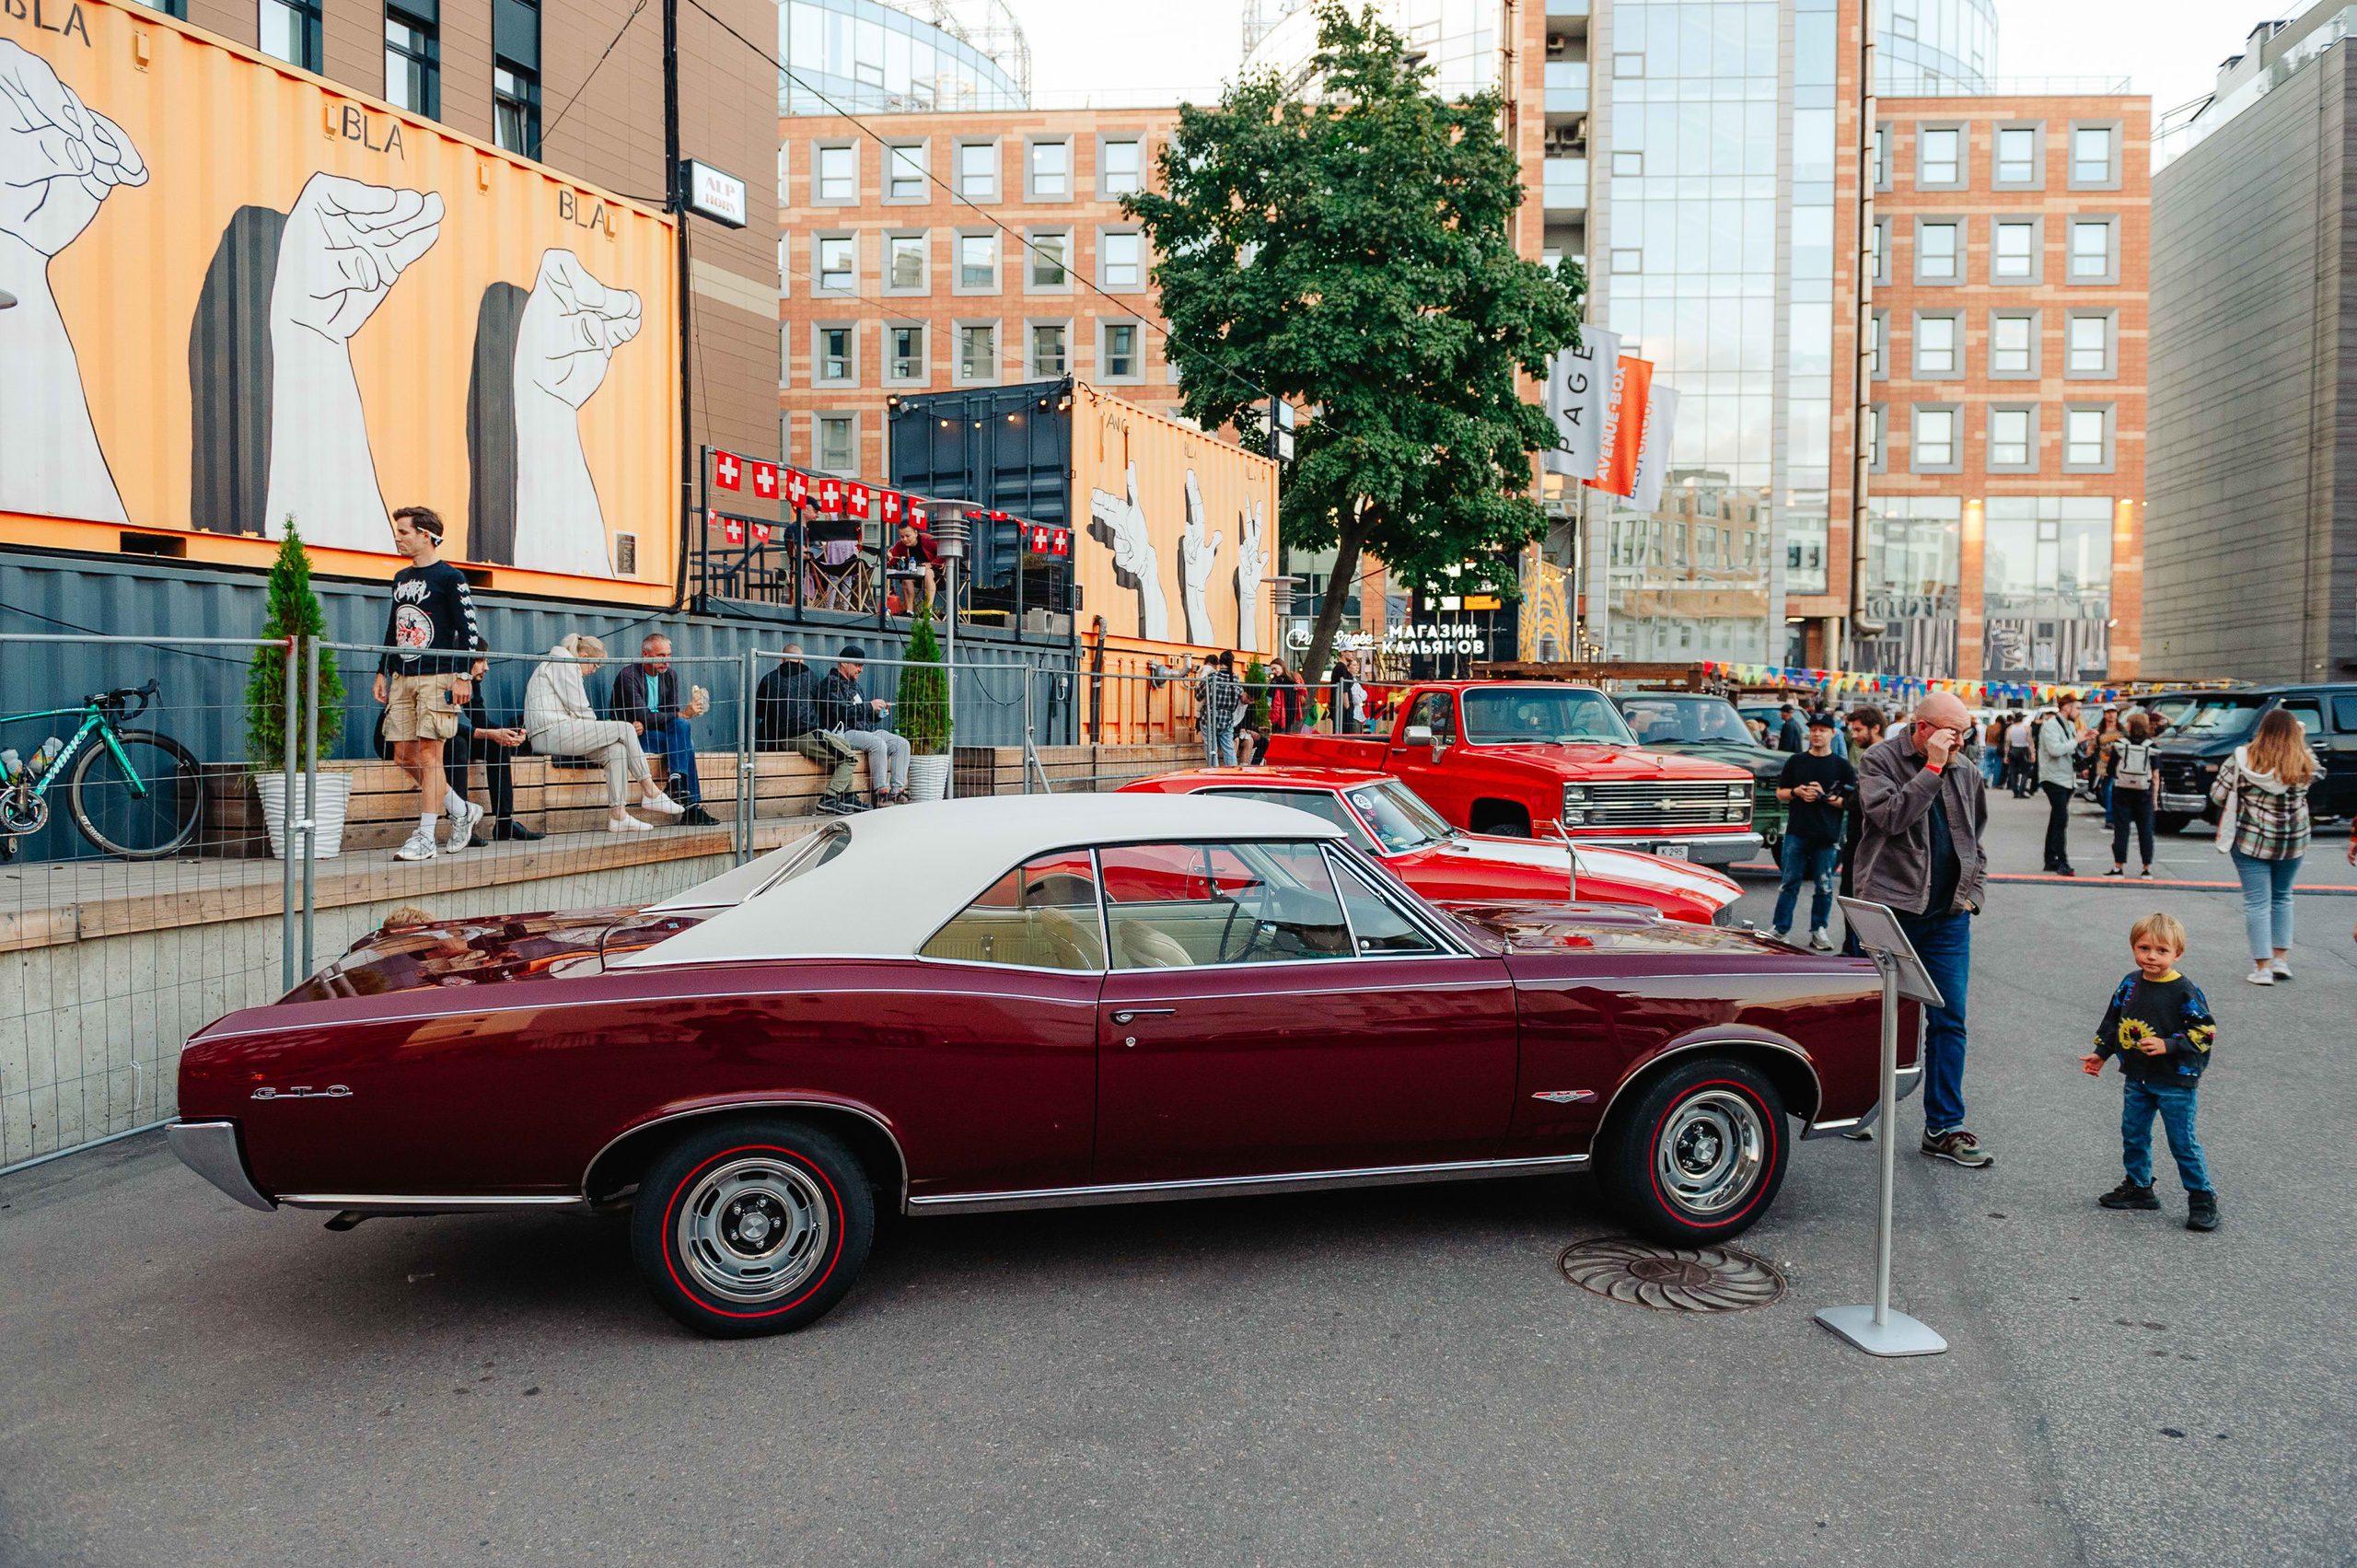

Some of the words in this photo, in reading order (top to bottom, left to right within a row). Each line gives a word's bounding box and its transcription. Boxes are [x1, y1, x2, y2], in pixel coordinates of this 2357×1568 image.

[343, 105, 404, 161] BLA
[705, 176, 736, 198] ALP
[560, 190, 608, 236] BLA
[1556, 345, 1595, 456] PAGE
[1596, 366, 1627, 482] AVENUE-BOX
[1332, 630, 1375, 646] Smoke
[1388, 623, 1478, 639] МАГАЗИН
[1381, 639, 1484, 655] КАЛЬЯНОВ
[1669, 847, 1684, 856] 295
[253, 1085, 350, 1100] GTO
